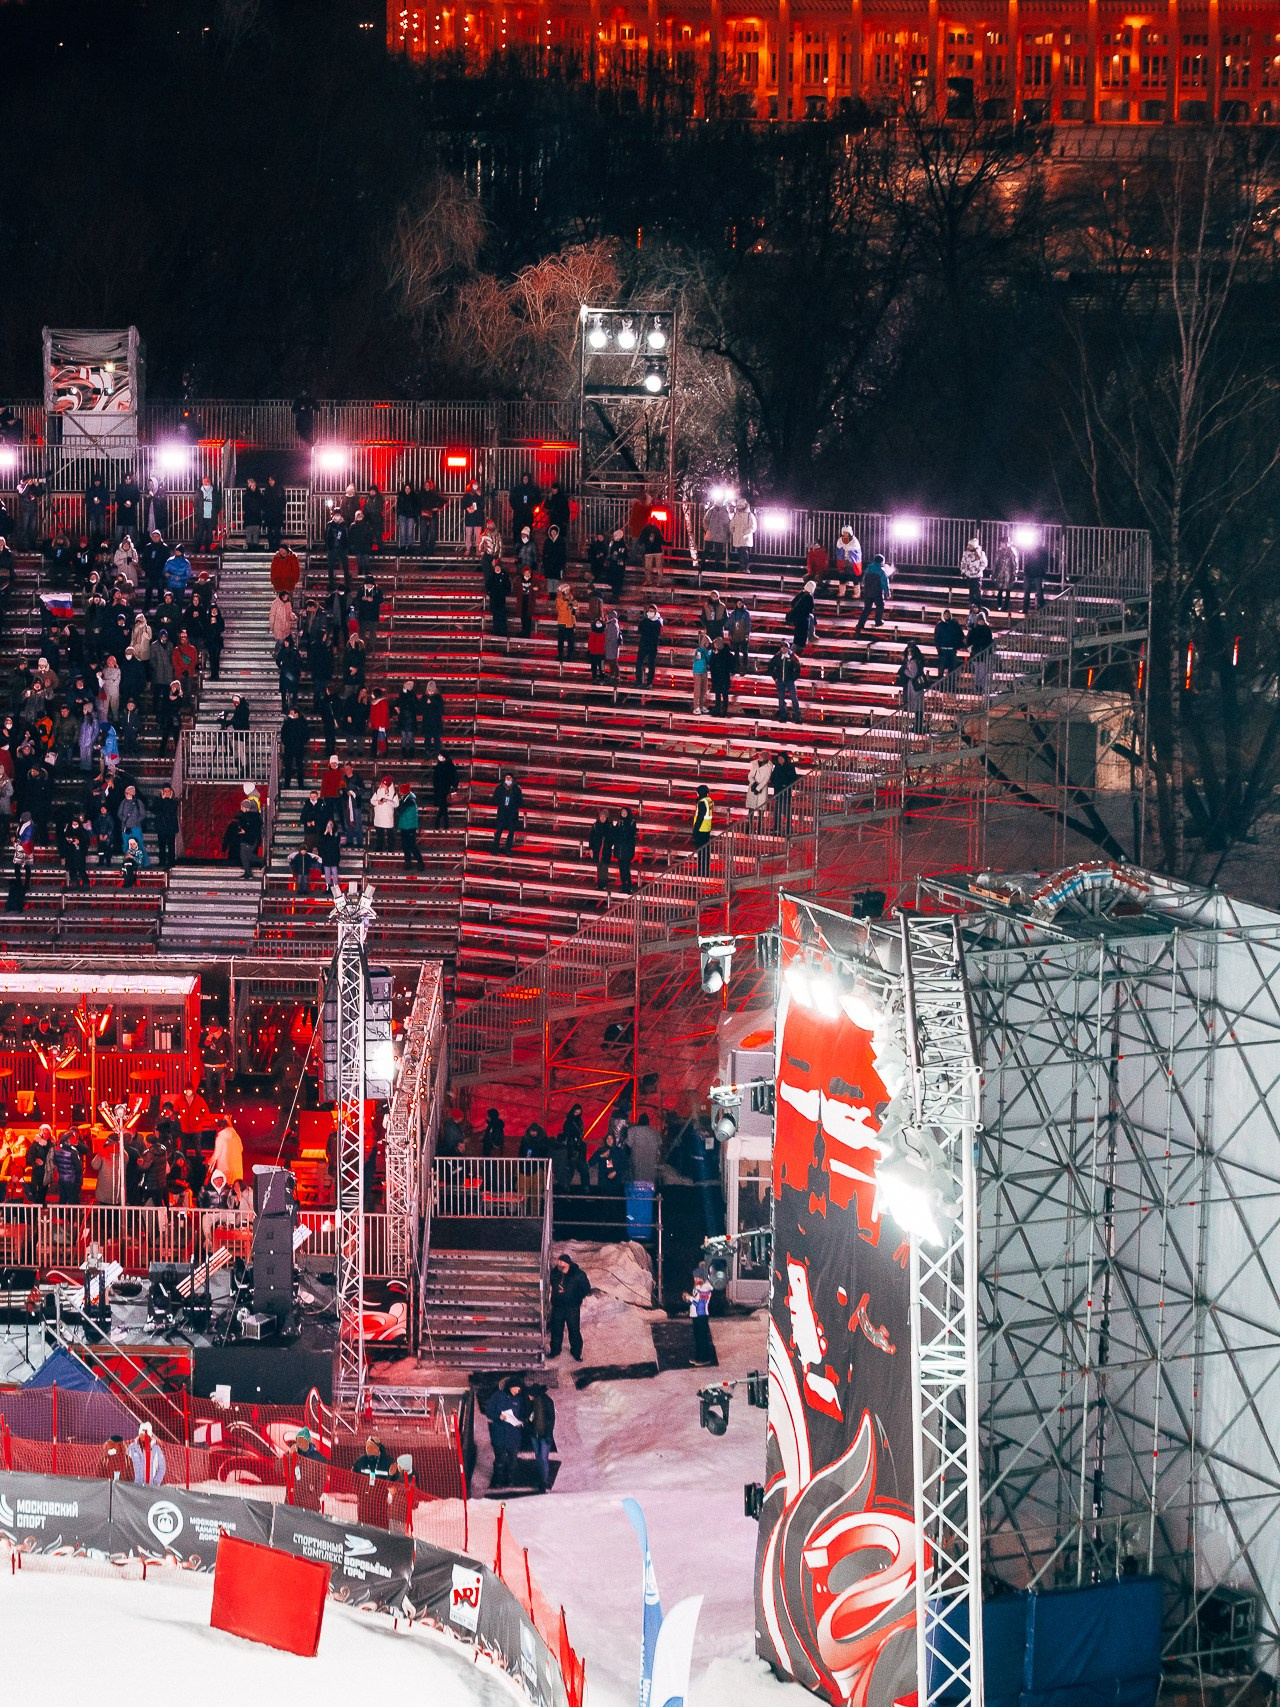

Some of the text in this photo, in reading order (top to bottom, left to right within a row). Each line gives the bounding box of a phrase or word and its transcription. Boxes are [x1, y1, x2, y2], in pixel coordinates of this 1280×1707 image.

[16, 1499, 79, 1518] МОСКОВСКИЙ
[16, 1514, 46, 1530] СПОРТ
[199, 1533, 219, 1543] ДОРО
[293, 1532, 344, 1555] СПОРТИВНЫЙ
[302, 1545, 343, 1565] КОМПЛЕКС
[343, 1565, 366, 1581] ГОРЫ
